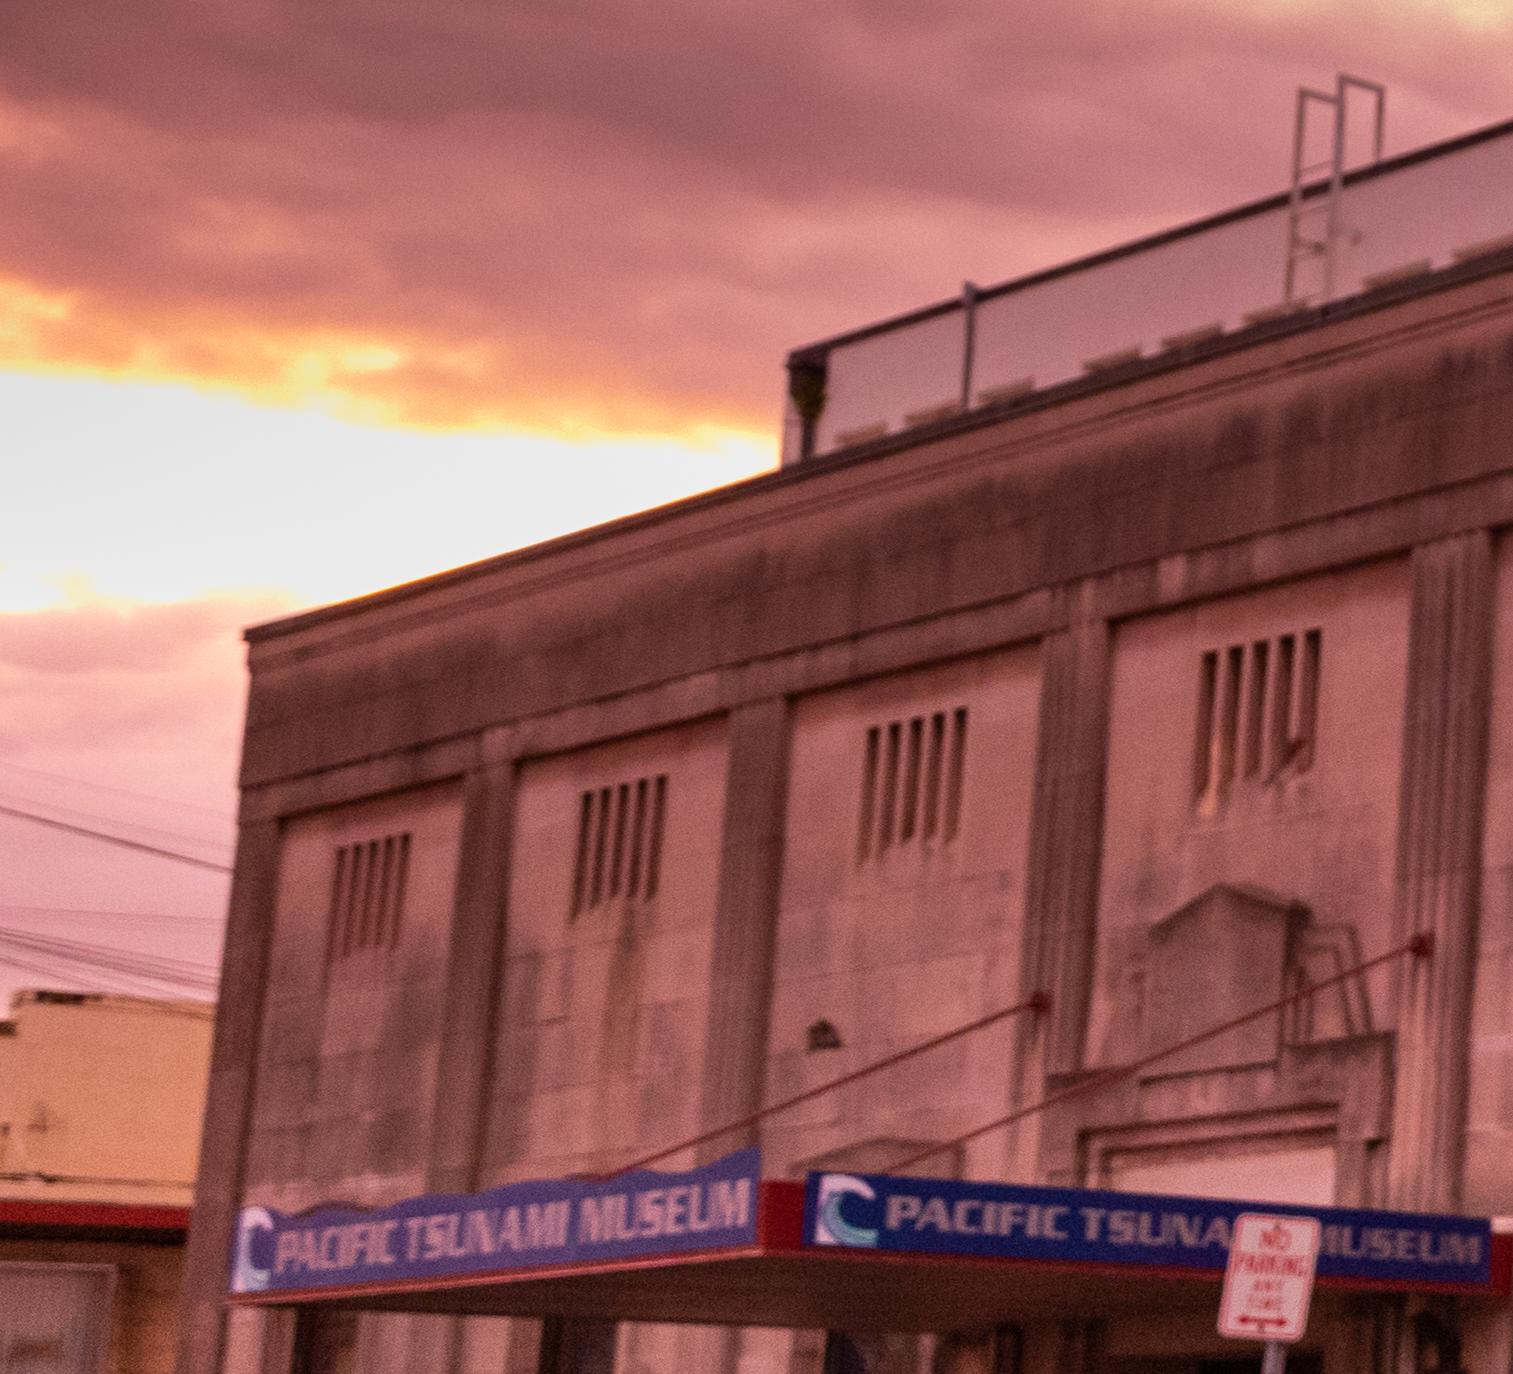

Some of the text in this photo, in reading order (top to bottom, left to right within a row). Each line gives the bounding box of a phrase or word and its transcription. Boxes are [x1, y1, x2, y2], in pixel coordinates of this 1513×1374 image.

[273, 1177, 751, 1275] PACIFIC TSUNAMI MUSEUM
[884, 1194, 1070, 1241] PACIFIC
[1078, 1205, 1236, 1250] TSUNA
[1259, 1229, 1292, 1251] NO
[1233, 1250, 1311, 1278] PARKING
